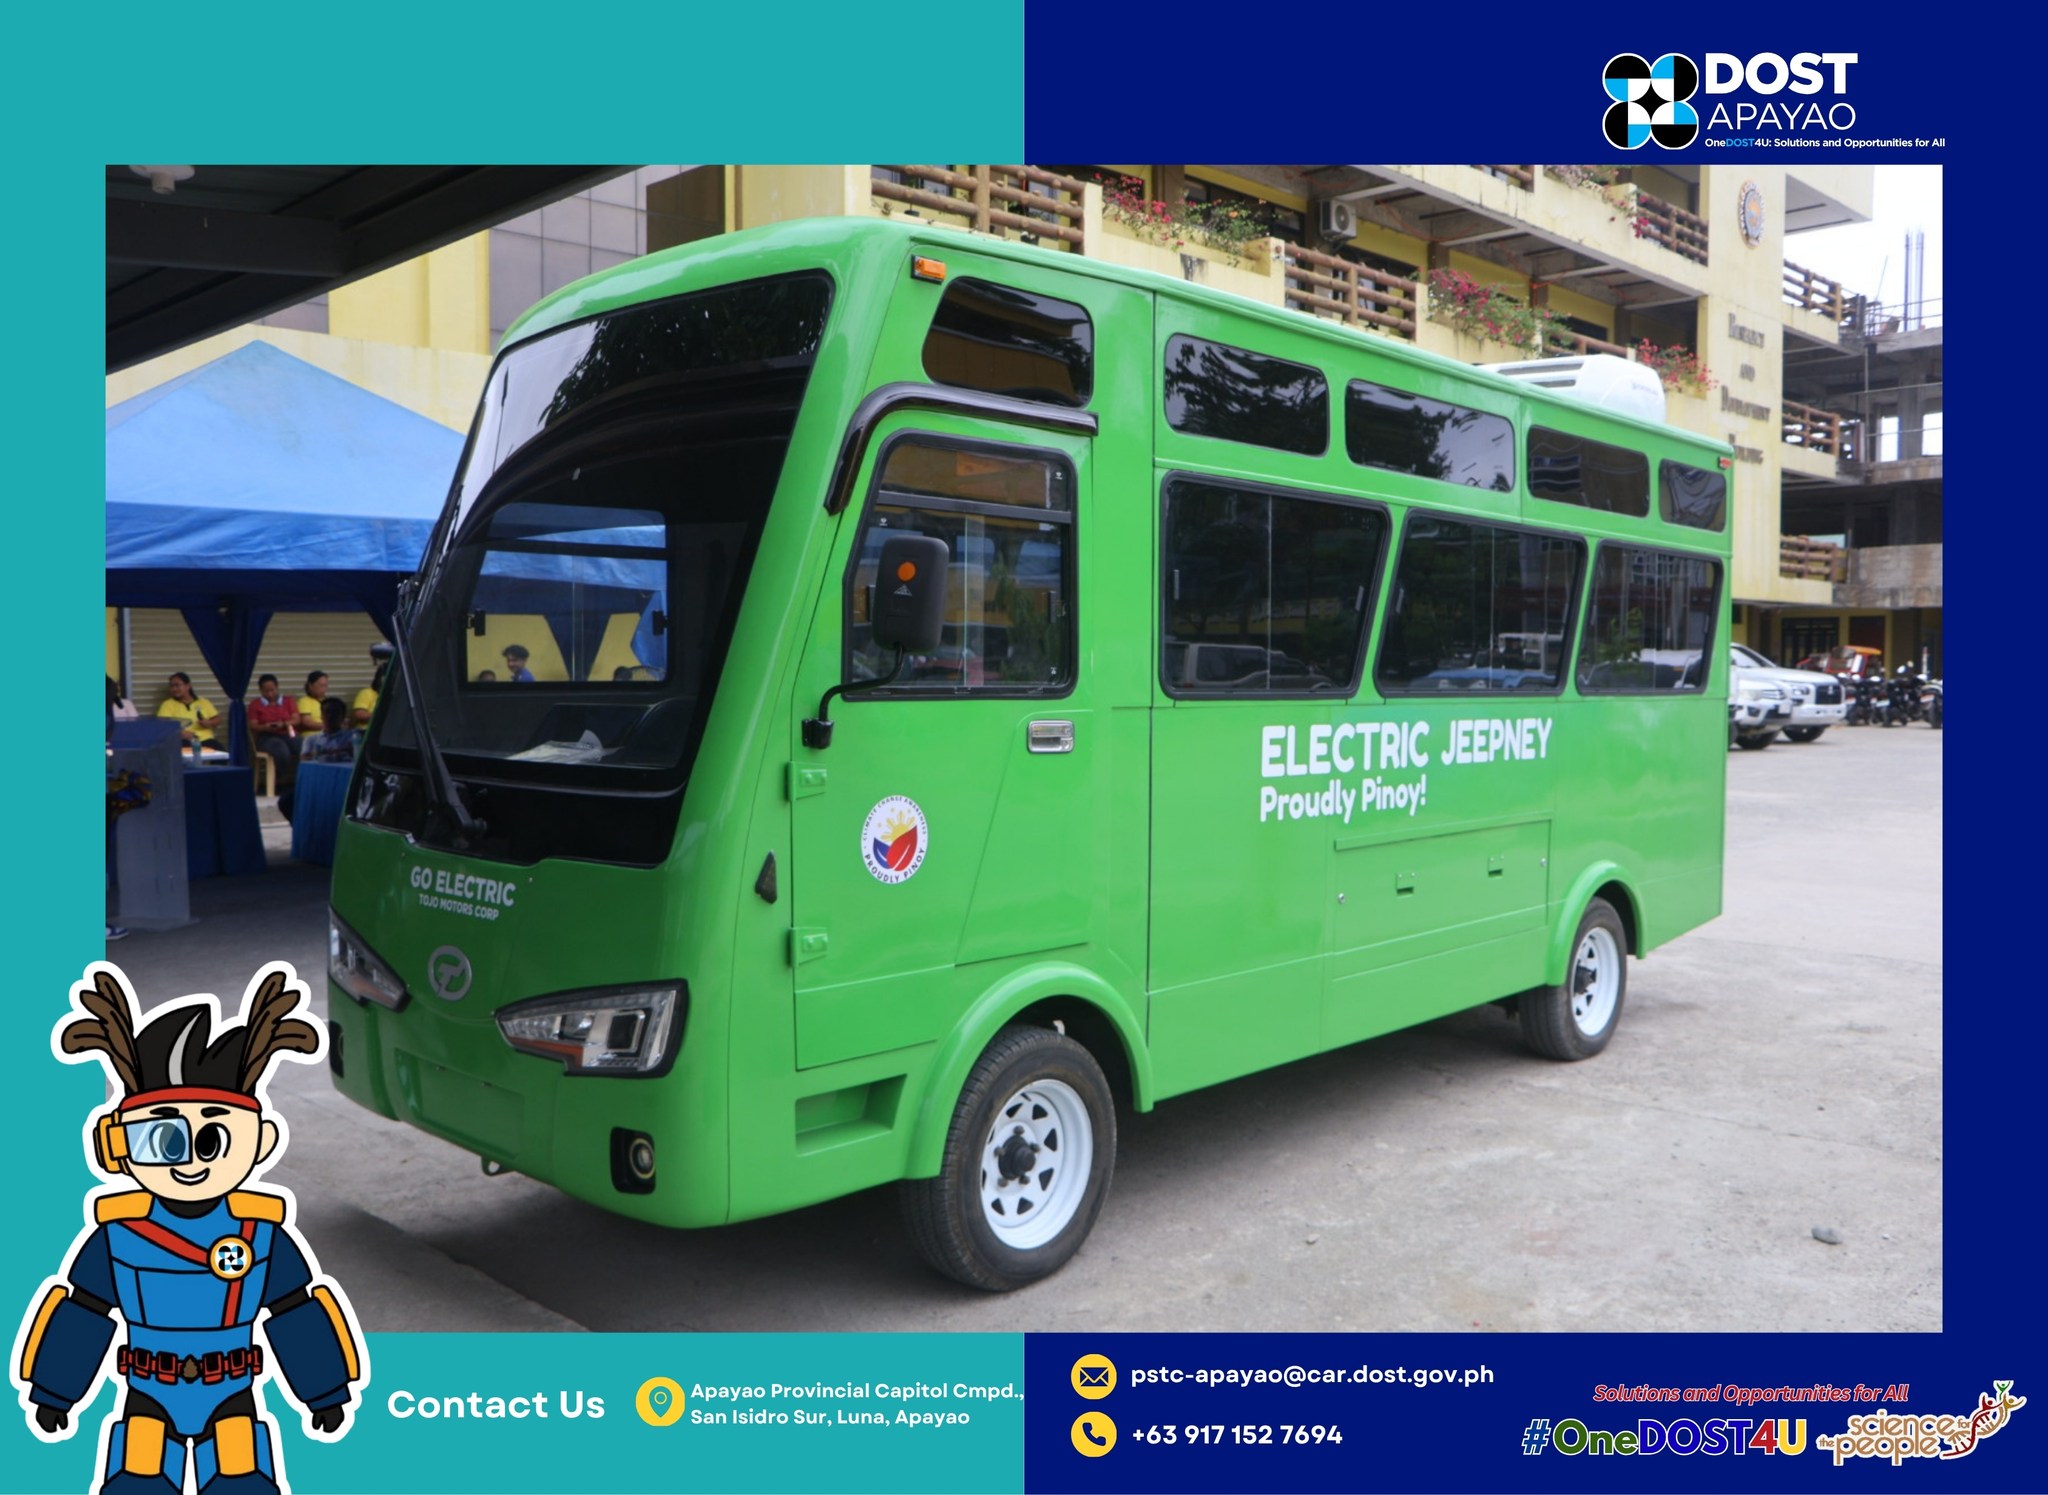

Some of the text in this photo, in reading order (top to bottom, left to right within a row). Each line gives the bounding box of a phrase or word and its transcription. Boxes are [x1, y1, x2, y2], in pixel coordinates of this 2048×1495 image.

[1261, 717, 1553, 778] ELECTRIC JEEPNEY
[1260, 774, 1427, 824] Proudly Pinoy!
[864, 847, 925, 883] PROUDLY PINOY
[410, 866, 516, 907] GO ELECTRIC
[418, 893, 499, 921] TOJO MOTORS CORP
